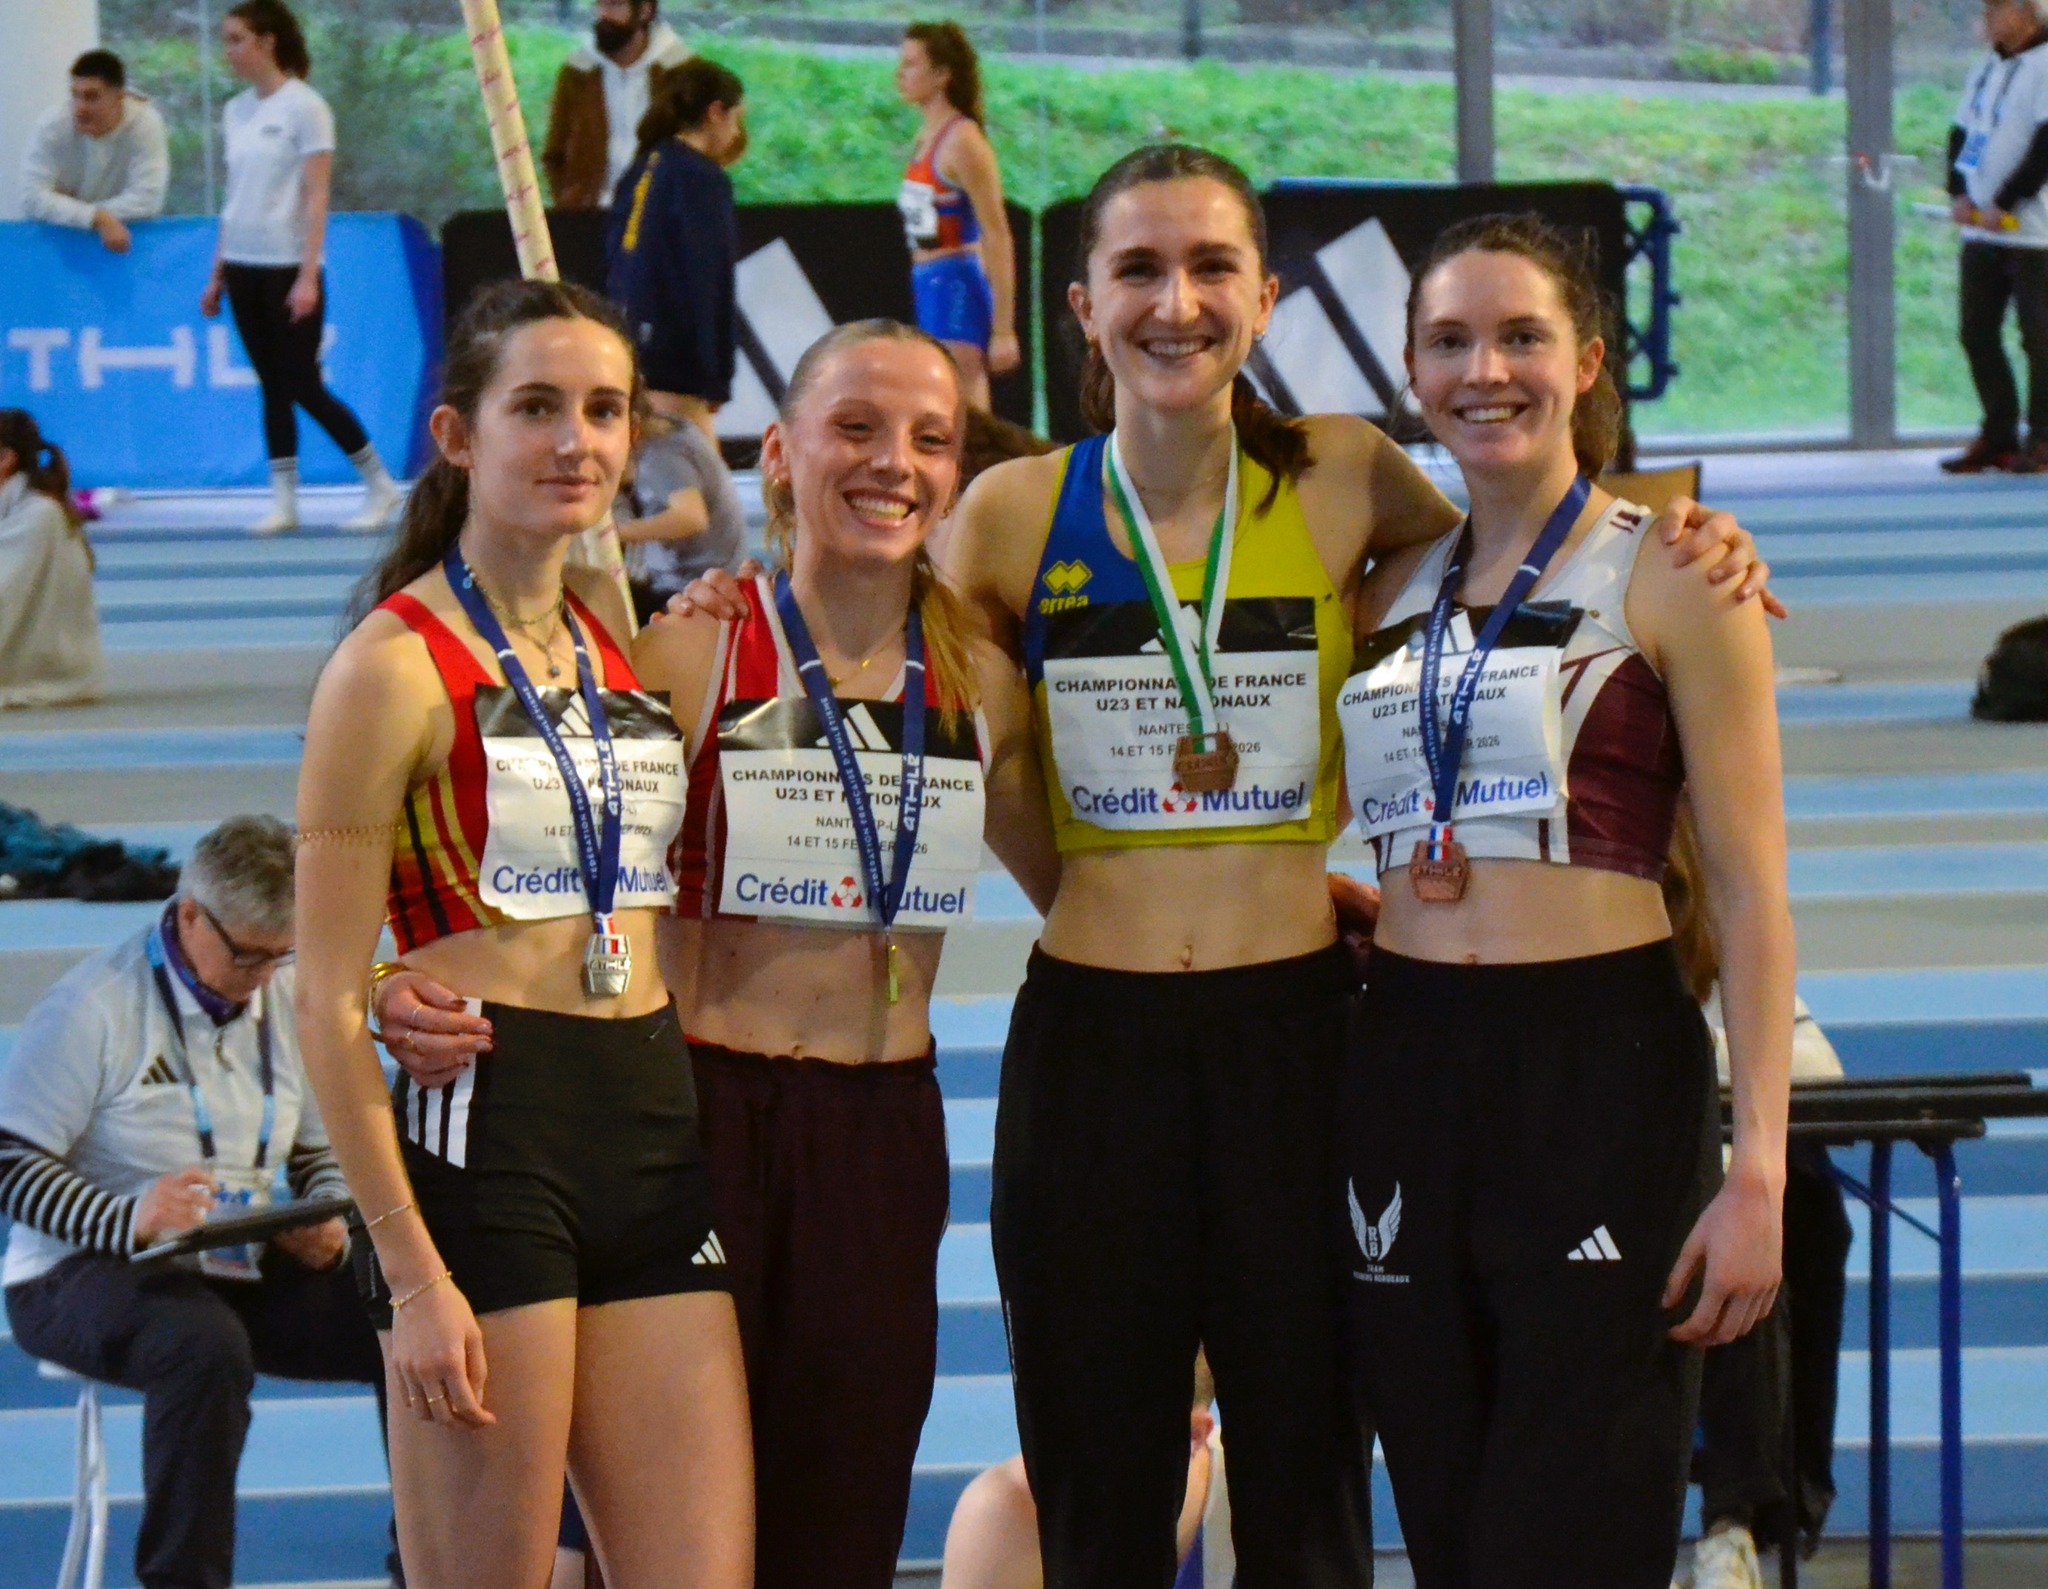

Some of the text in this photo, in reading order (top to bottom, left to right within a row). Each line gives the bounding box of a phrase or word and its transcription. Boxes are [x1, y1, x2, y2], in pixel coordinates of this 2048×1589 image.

[7, 326, 336, 392] THL
[1055, 677, 1177, 693] CHAMPIONNA
[1235, 673, 1306, 688] FRANCE
[1480, 665, 1539, 683] FRANCE
[1096, 697, 1130, 711] U23
[1136, 697, 1158, 711] ET
[1372, 703, 1398, 719] U23
[1401, 699, 1418, 714] ET
[1110, 746, 1124, 757] 14
[1127, 745, 1143, 757] ET
[1149, 744, 1163, 756] 15
[1383, 752, 1394, 764] 14
[1396, 748, 1408, 761] ET
[633, 760, 680, 776] FRANCE
[732, 769, 874, 786] CHAMPIONNS
[879, 774, 901, 787] DE
[775, 788, 808, 801] U23
[814, 789, 835, 802] ET
[902, 754, 921, 832] ATHLÉ
[1072, 782, 1305, 814] Crédit Mutuel
[1455, 771, 1549, 807] Mutuel
[544, 825, 557, 837] 14
[787, 835, 801, 847] 14
[805, 836, 822, 848] ET
[826, 838, 839, 850] 15
[492, 866, 582, 894] Crédit
[736, 873, 966, 914] Crédit utuel
